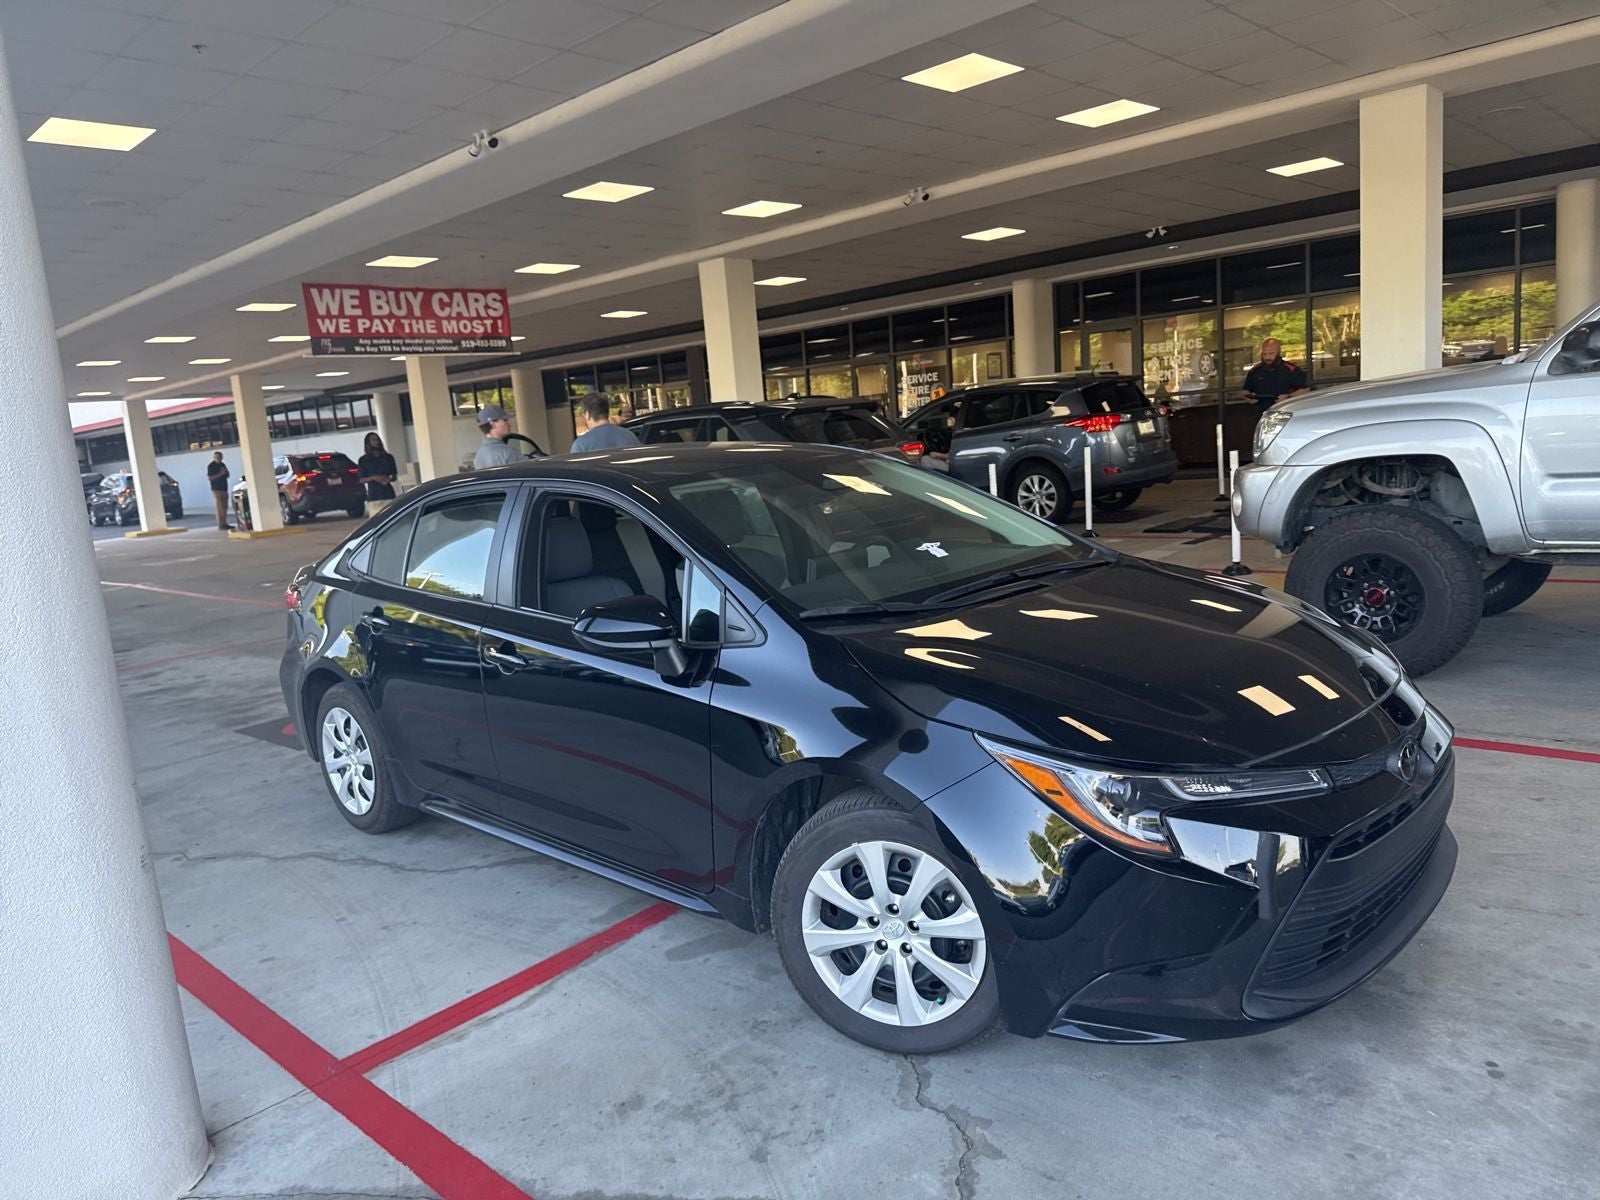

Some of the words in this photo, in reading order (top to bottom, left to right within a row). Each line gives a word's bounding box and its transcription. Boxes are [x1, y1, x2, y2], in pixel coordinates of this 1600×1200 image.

[310, 288, 363, 316] WE
[368, 289, 425, 318] BUY
[431, 291, 504, 318] CARS
[316, 318, 352, 334] WE
[357, 318, 396, 334] PAY
[399, 318, 438, 334] THE
[1150, 338, 1204, 353] SERVICE
[1163, 353, 1190, 367] TIRE
[1150, 367, 1192, 382] ENTER
